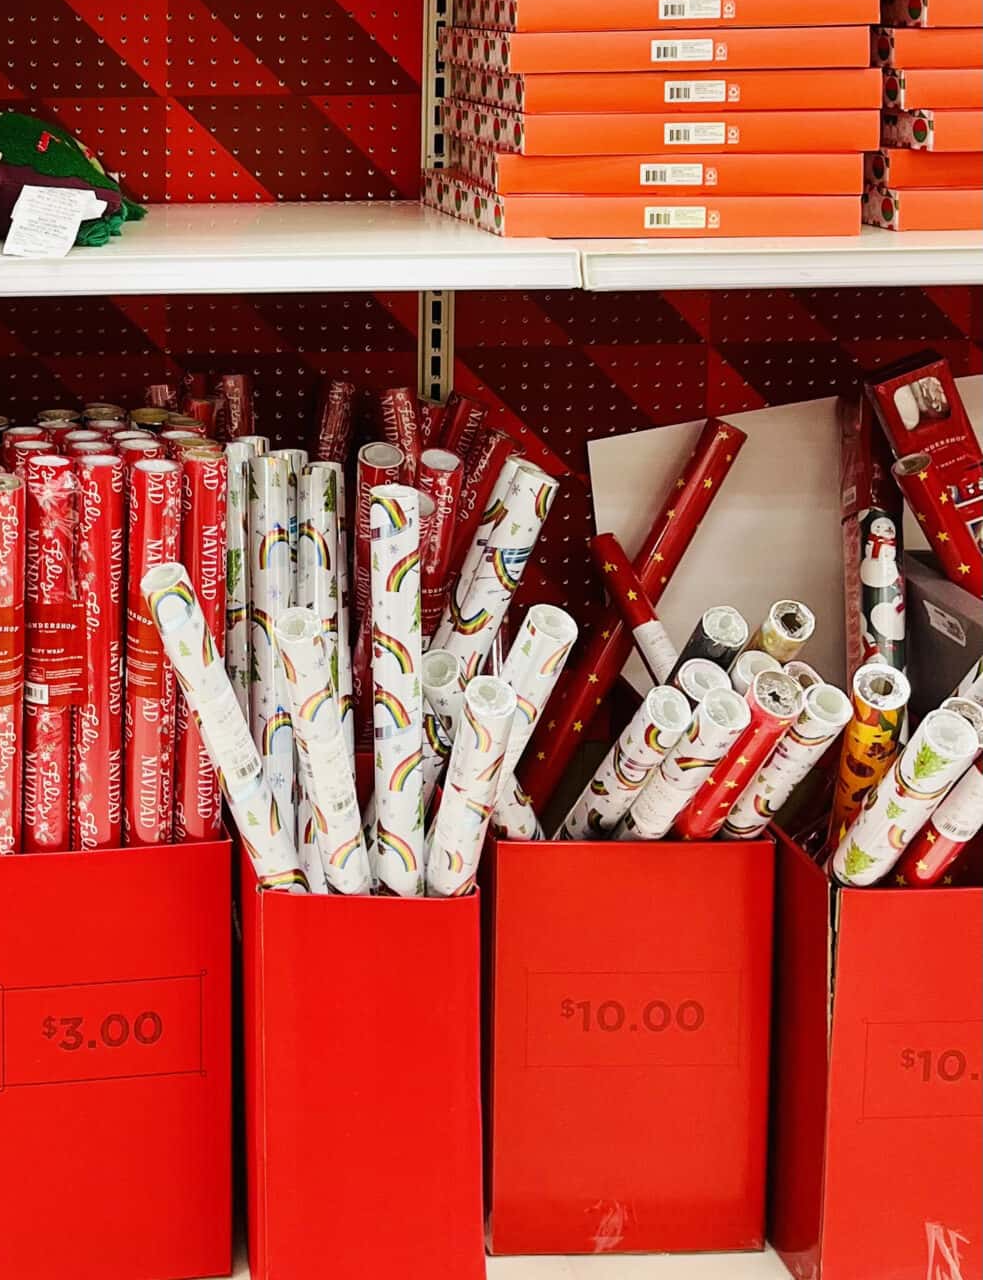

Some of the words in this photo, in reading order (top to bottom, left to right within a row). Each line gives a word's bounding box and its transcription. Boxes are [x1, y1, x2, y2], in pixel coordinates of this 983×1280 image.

[110, 528, 122, 603] NAVIDAD
[201, 525, 218, 601] NAVIDAD
[110, 640, 121, 714] NAVIDAD
[25, 751, 37, 826] NAVIDAD
[108, 749, 121, 824] NAVIDAD
[140, 755, 158, 829] NAVIDAD
[42, 1011, 163, 1051] $3.00
[560, 998, 705, 1034] $10.00
